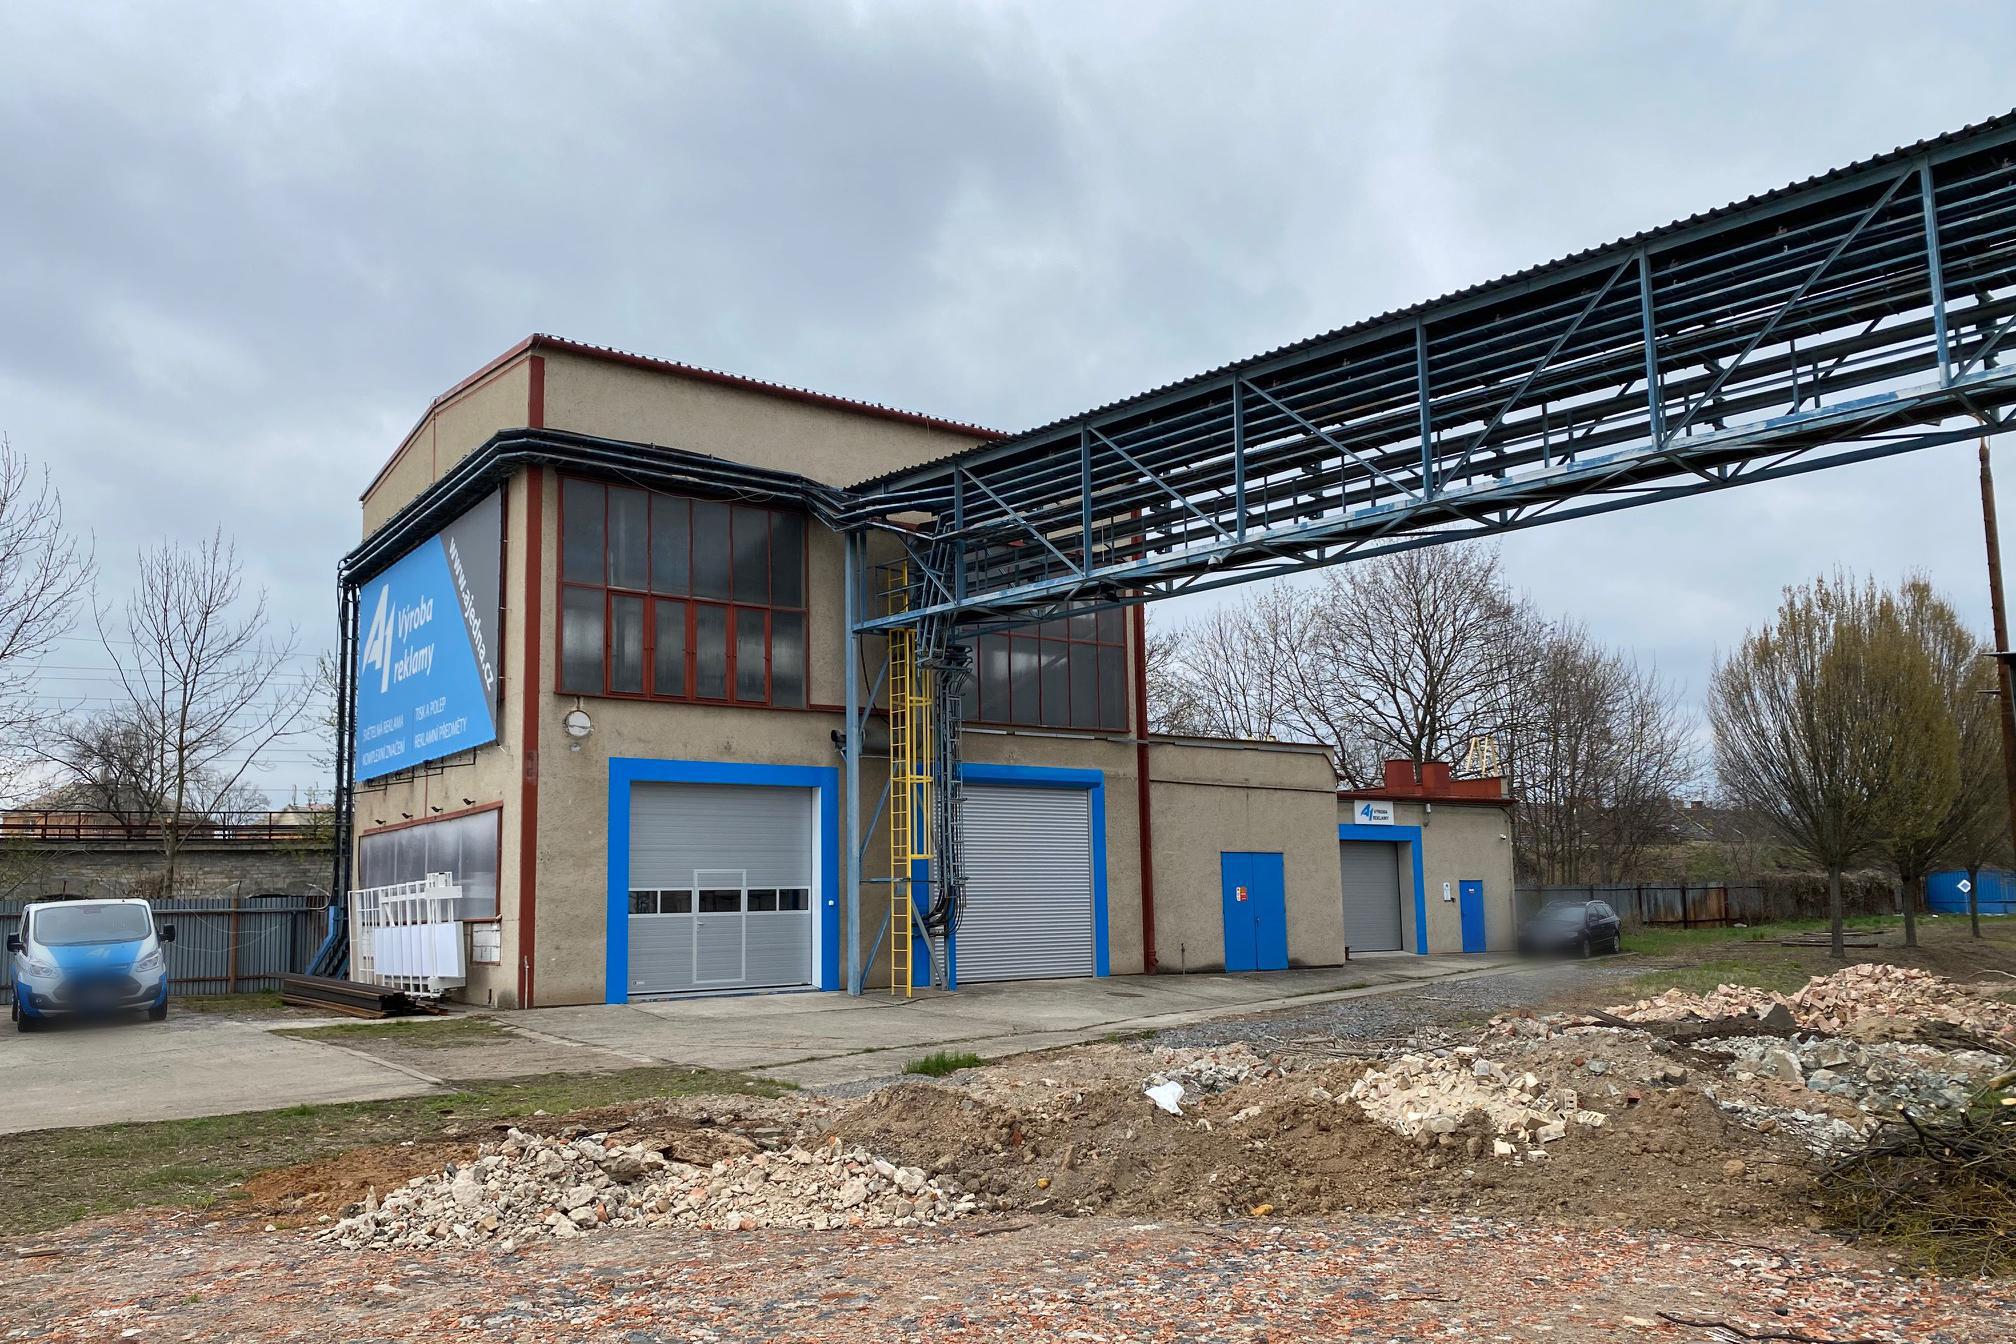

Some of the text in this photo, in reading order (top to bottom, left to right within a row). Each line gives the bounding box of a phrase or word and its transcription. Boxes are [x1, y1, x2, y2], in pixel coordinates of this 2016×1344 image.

[397, 595, 434, 643] Výroba
[449, 537, 495, 692] www.ajedna.cz
[393, 642, 435, 684] reklamy
